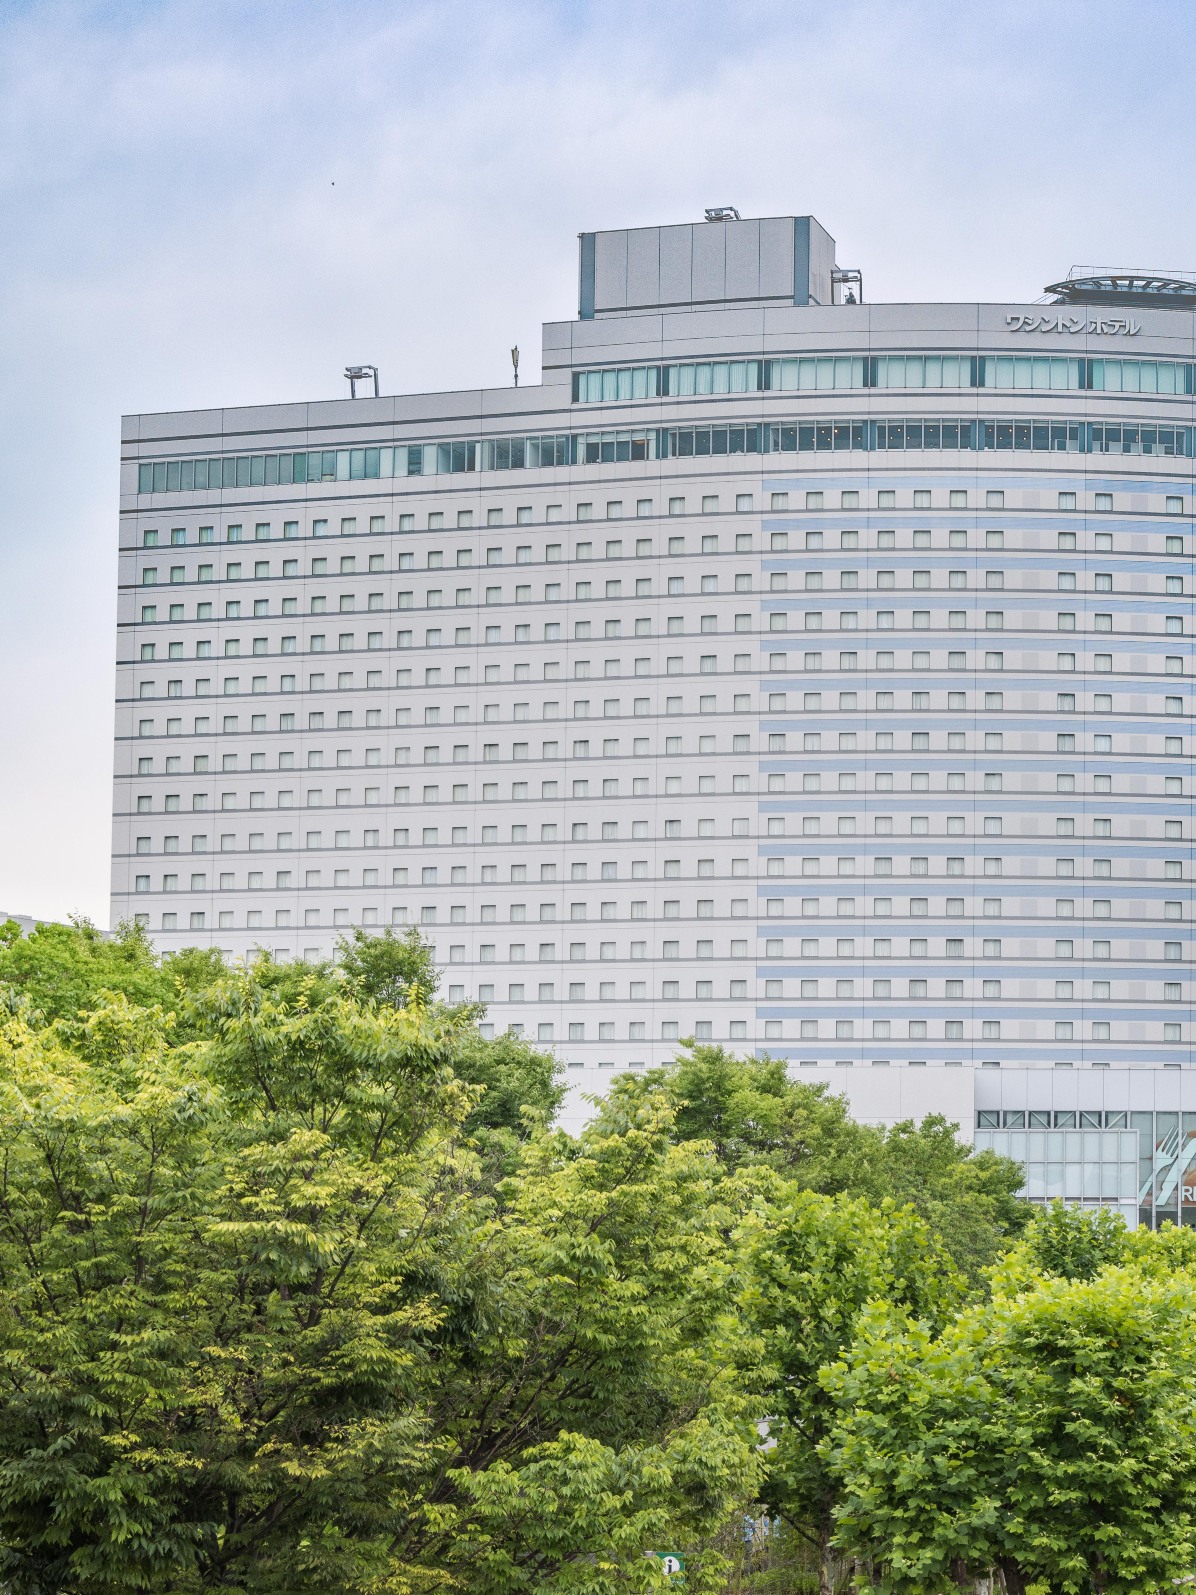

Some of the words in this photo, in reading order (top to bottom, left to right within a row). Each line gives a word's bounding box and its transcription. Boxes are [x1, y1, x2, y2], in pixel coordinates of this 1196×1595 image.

[1006, 314, 1142, 336] ワシントンホテル
